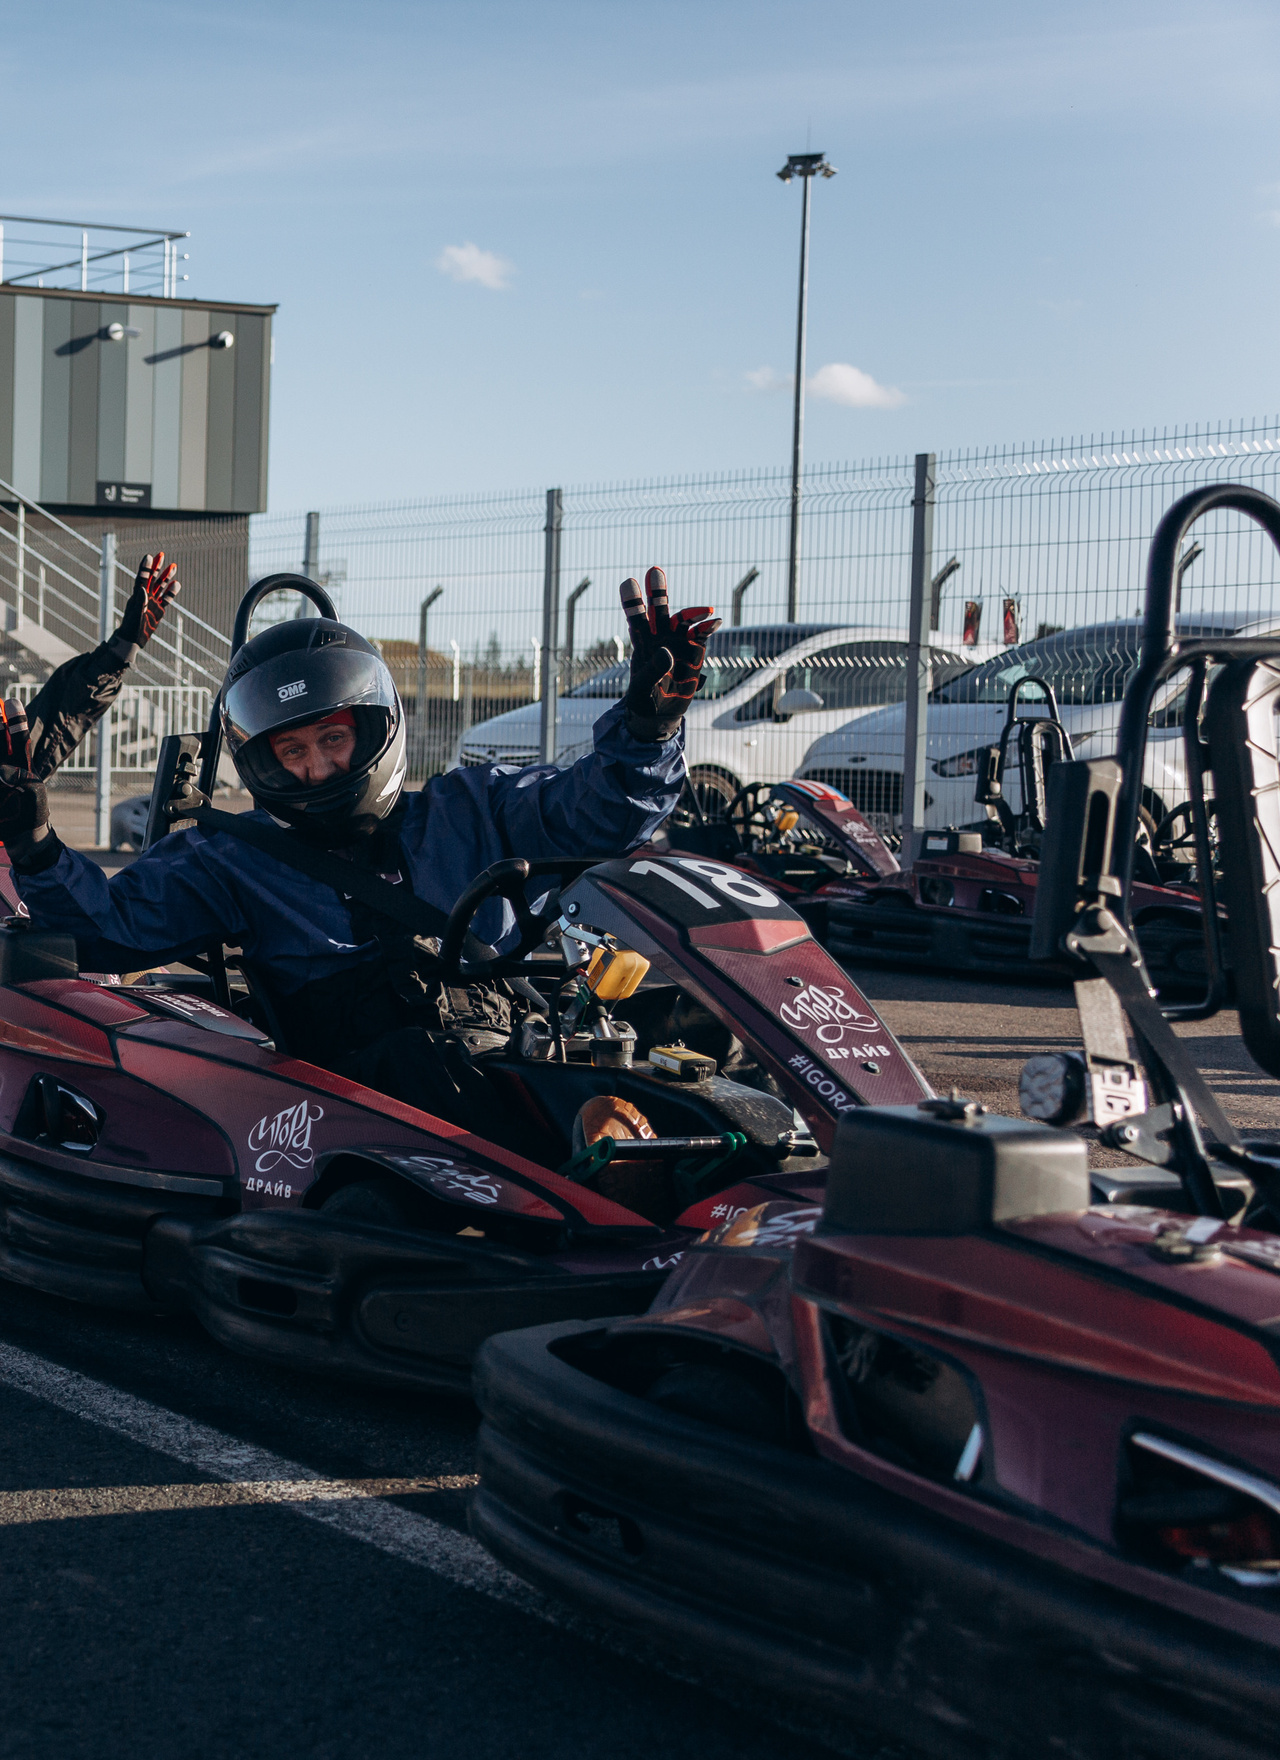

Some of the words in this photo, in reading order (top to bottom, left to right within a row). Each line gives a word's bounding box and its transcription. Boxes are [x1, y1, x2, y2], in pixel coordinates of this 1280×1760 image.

[278, 682, 307, 699] OMP
[628, 859, 780, 910] 18
[825, 1043, 891, 1060] ДРАЙВ
[245, 1176, 293, 1199] ДРАЙВ
